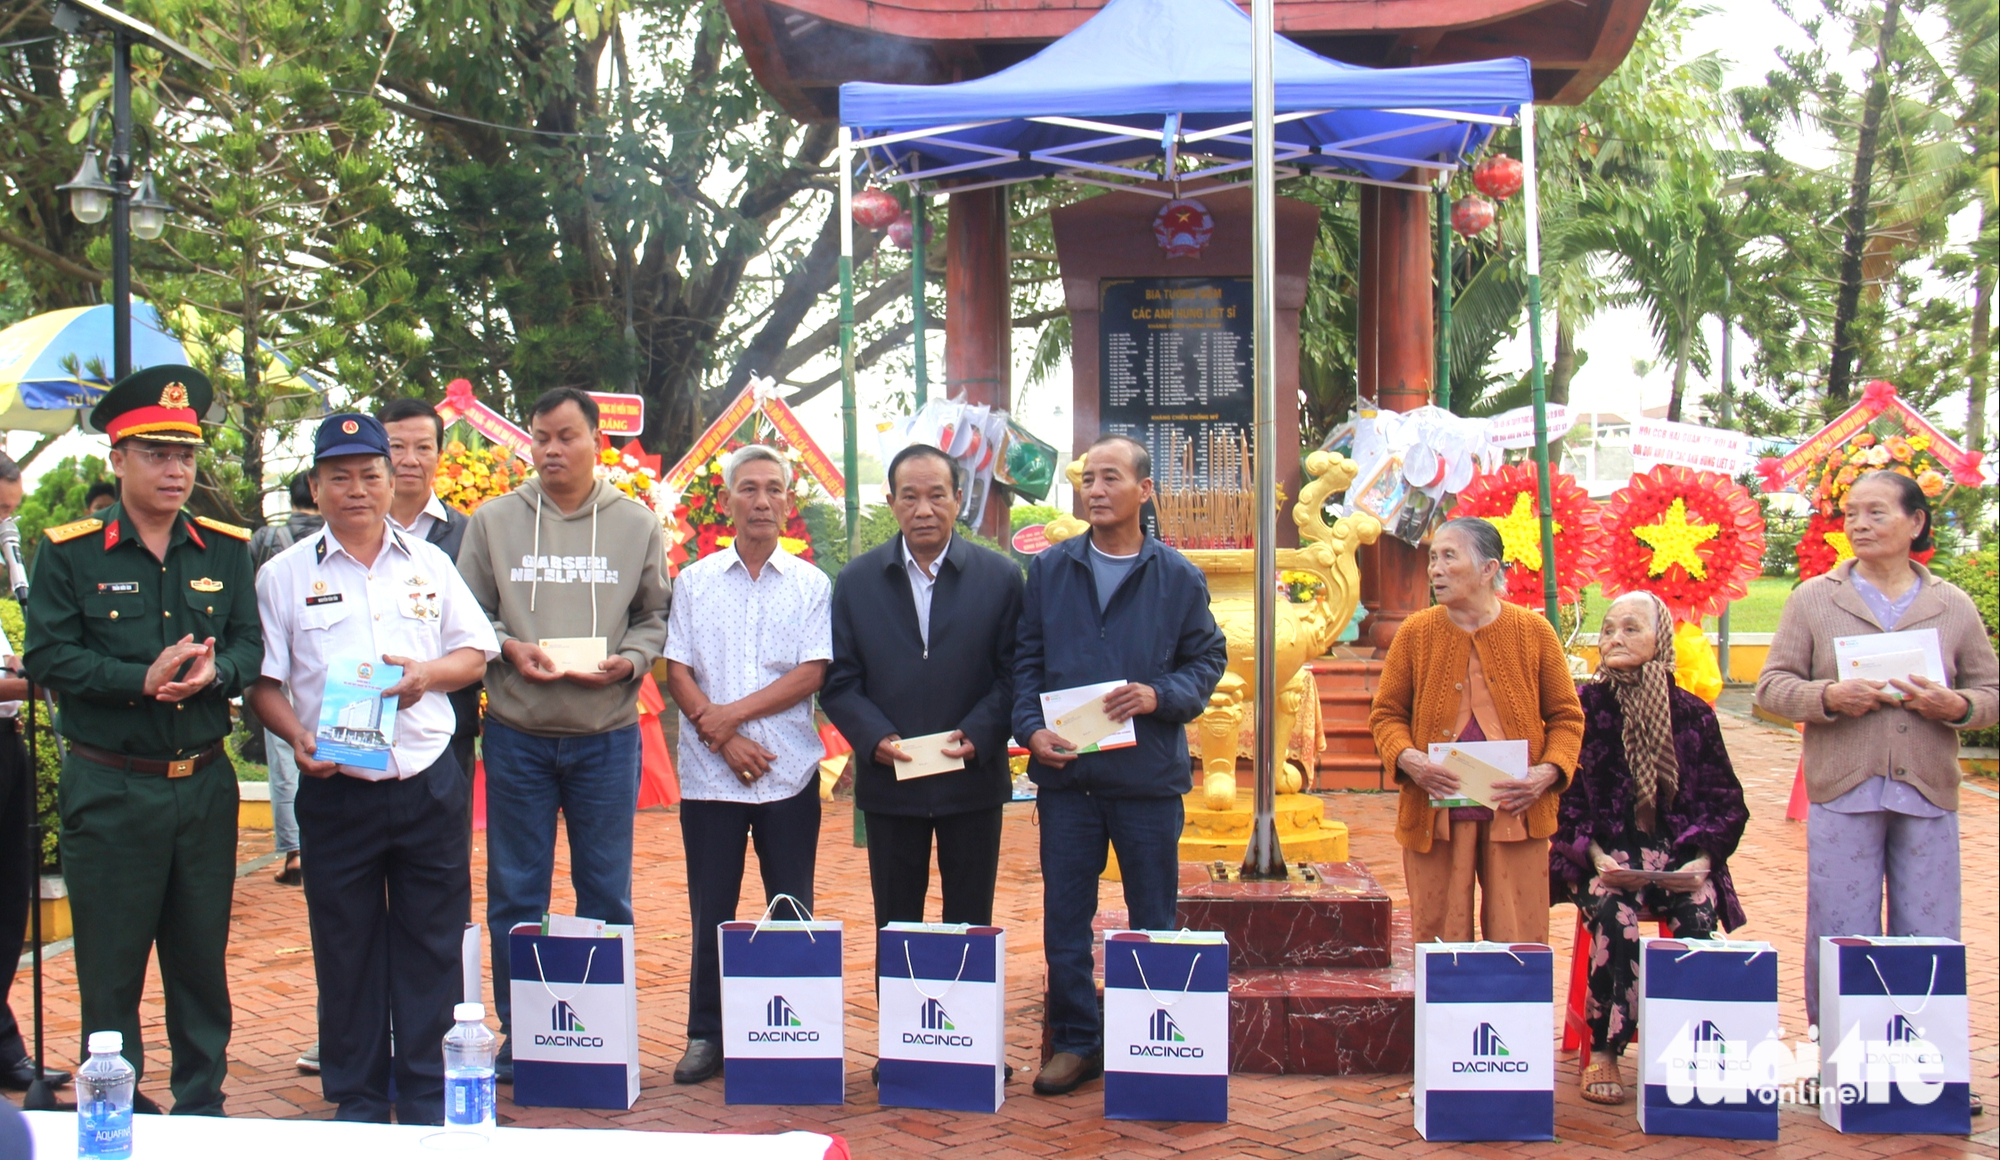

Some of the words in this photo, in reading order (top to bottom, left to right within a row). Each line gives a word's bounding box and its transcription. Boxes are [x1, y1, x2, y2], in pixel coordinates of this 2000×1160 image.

[1145, 289, 1161, 300] BIA
[1132, 305, 1151, 319] CÁC
[1154, 308, 1174, 319] ANH
[534, 1034, 603, 1047] DACINCO
[749, 1031, 820, 1042] DACINCO
[902, 1032, 973, 1047] DACINCO
[1130, 1045, 1204, 1058] DACINCO
[1452, 1061, 1528, 1073] DACINCO
